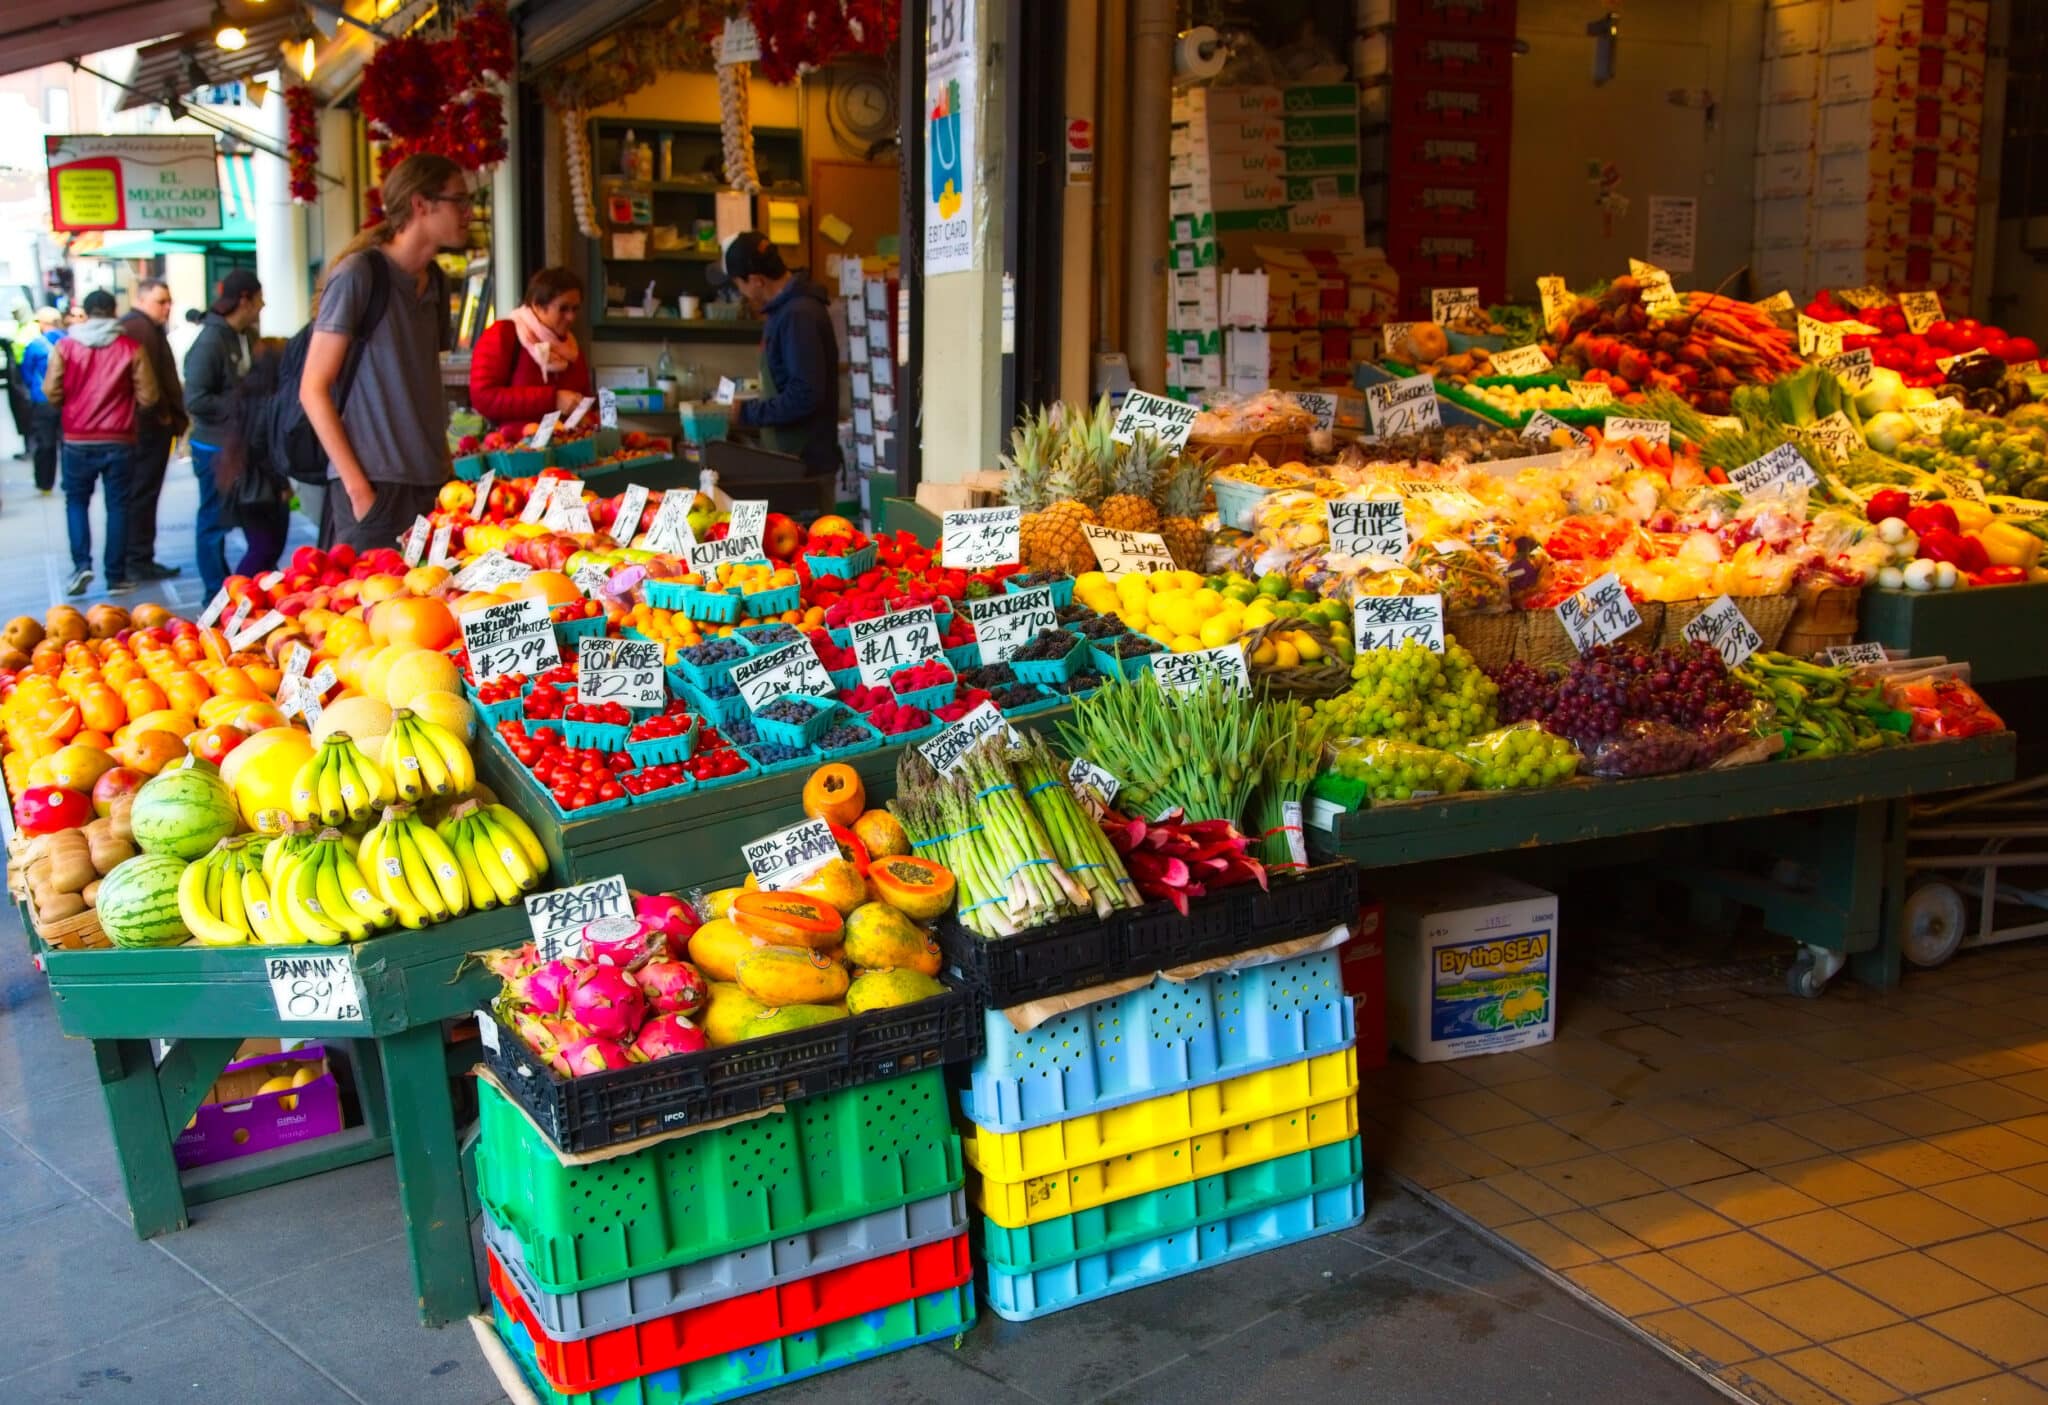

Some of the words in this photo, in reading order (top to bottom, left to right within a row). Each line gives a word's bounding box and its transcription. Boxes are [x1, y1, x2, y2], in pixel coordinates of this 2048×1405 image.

[128, 188, 221, 201] MERCADO
[142, 206, 206, 218] LATINO
[928, 224, 943, 243] EBT
[945, 220, 967, 240] CARD
[1125, 393, 1199, 424] PINEAPPLE
[1087, 526, 1136, 543] LEMON
[1333, 516, 1403, 536] CHIPS
[691, 535, 759, 565] KUMQUAT
[1121, 542, 1167, 555] LIME
[485, 601, 531, 619] ORGANIC
[974, 590, 1050, 620] BLACKBERRY
[1355, 597, 1414, 611] GREEN
[854, 608, 933, 638] RASPBERRY
[1367, 606, 1439, 624] GRAPES
[981, 625, 997, 642] 2
[1746, 632, 1759, 650] LB
[736, 640, 808, 682] BLUEBERRY
[641, 690, 662, 702] BOX
[752, 681, 777, 705] 2
[748, 840, 783, 860] ROYAL
[786, 823, 830, 846] STAR
[753, 855, 783, 876] RED
[529, 880, 622, 917] DRAGON
[548, 896, 619, 929] FRUIT
[1440, 950, 1467, 975] By
[1470, 945, 1503, 968] the
[1504, 936, 1543, 963] SEA
[271, 957, 350, 980] BANANAS
[337, 1004, 360, 1020] LB
[664, 1111, 685, 1123] IFCO
